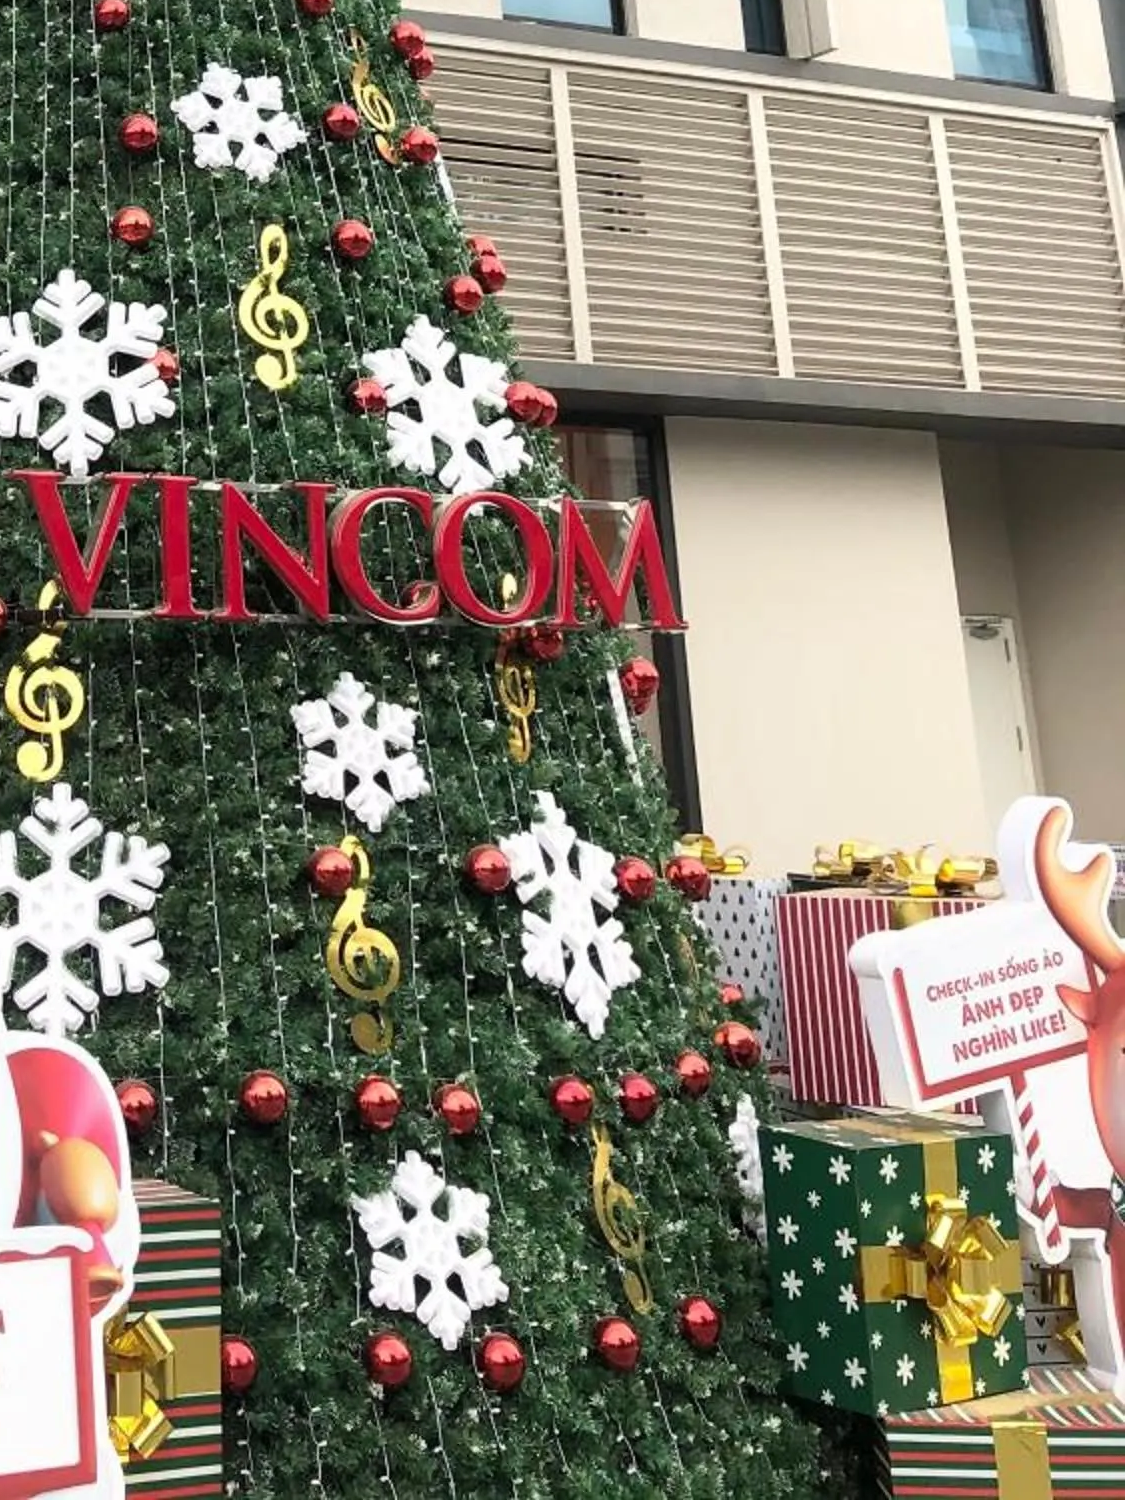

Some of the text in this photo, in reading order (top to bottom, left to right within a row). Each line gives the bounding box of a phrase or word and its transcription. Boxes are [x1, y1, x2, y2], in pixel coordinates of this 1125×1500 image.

[6, 468, 688, 632] VINCOM
[926, 970, 996, 1003] CHECK-IN
[998, 956, 1039, 982] SỐNG
[961, 985, 1044, 1027] ẢNH ĐẸP
[952, 1009, 1067, 1063] NGHÌN LIKE!
